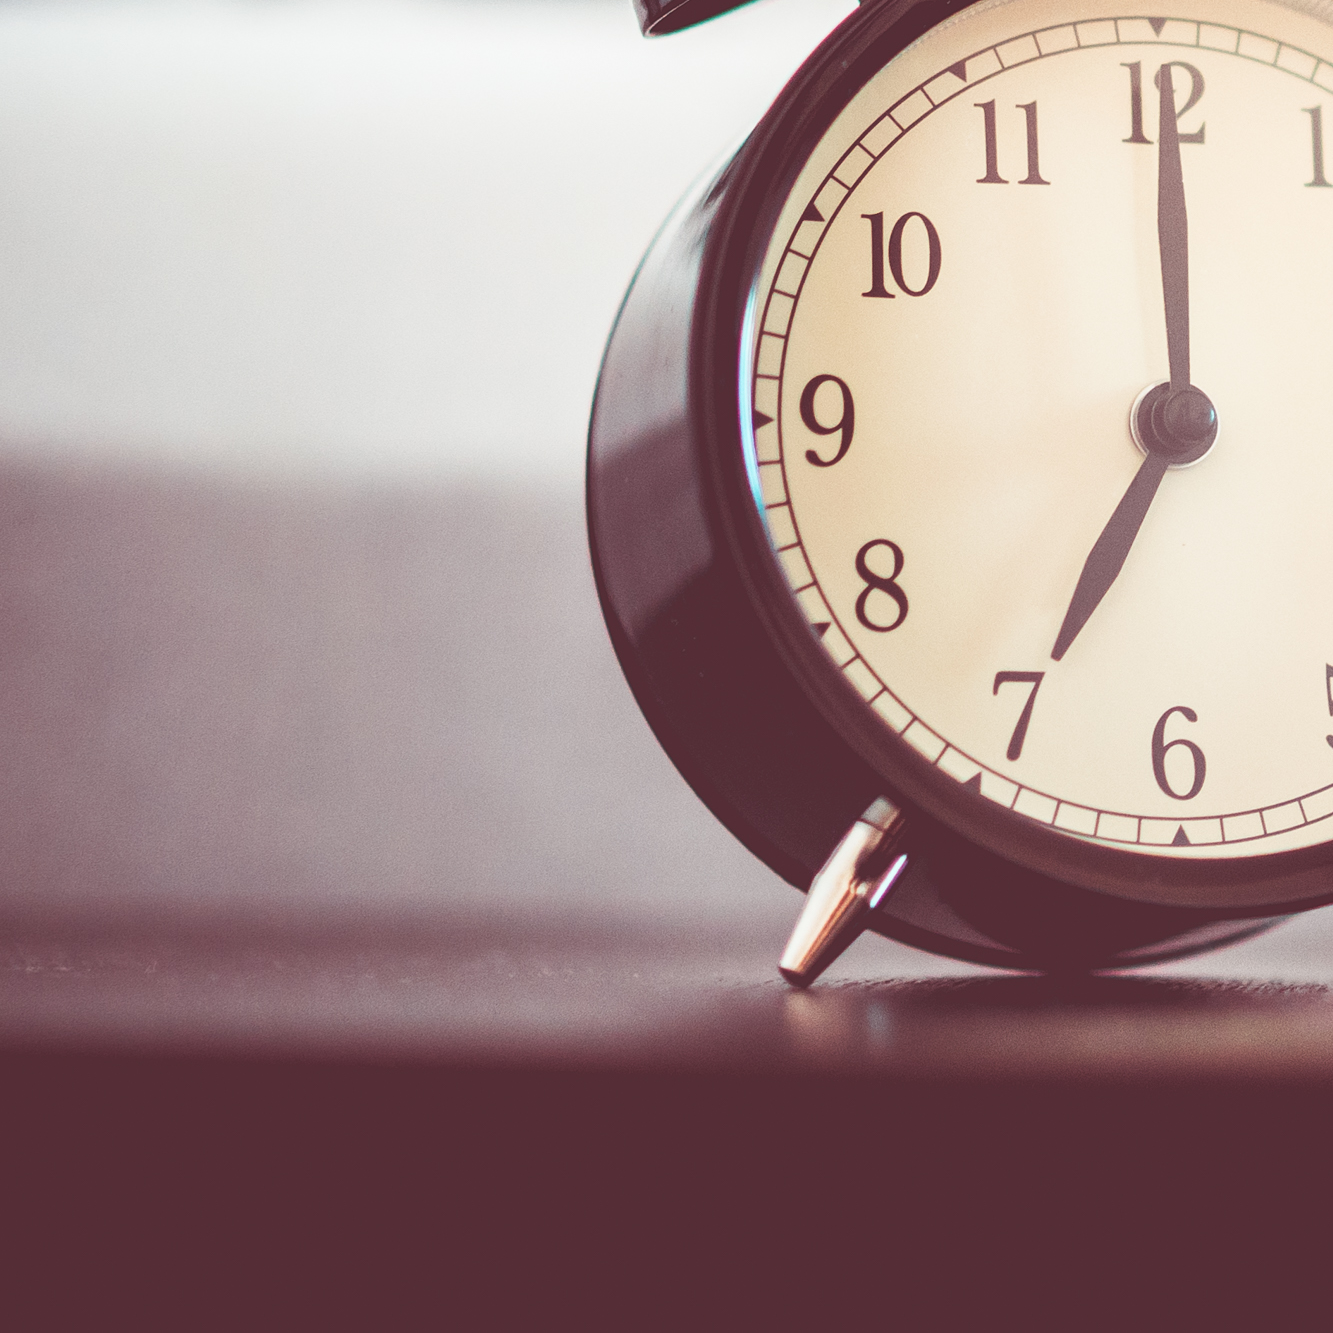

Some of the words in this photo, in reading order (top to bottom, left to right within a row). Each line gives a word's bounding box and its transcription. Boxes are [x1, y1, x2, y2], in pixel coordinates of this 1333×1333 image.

[974, 100, 1051, 186] 11
[1120, 60, 1206, 145] 12
[861, 211, 942, 298] 10
[799, 374, 855, 467] 9
[855, 539, 909, 632] 8
[993, 671, 1046, 761] 7
[1151, 706, 1206, 801] 6
